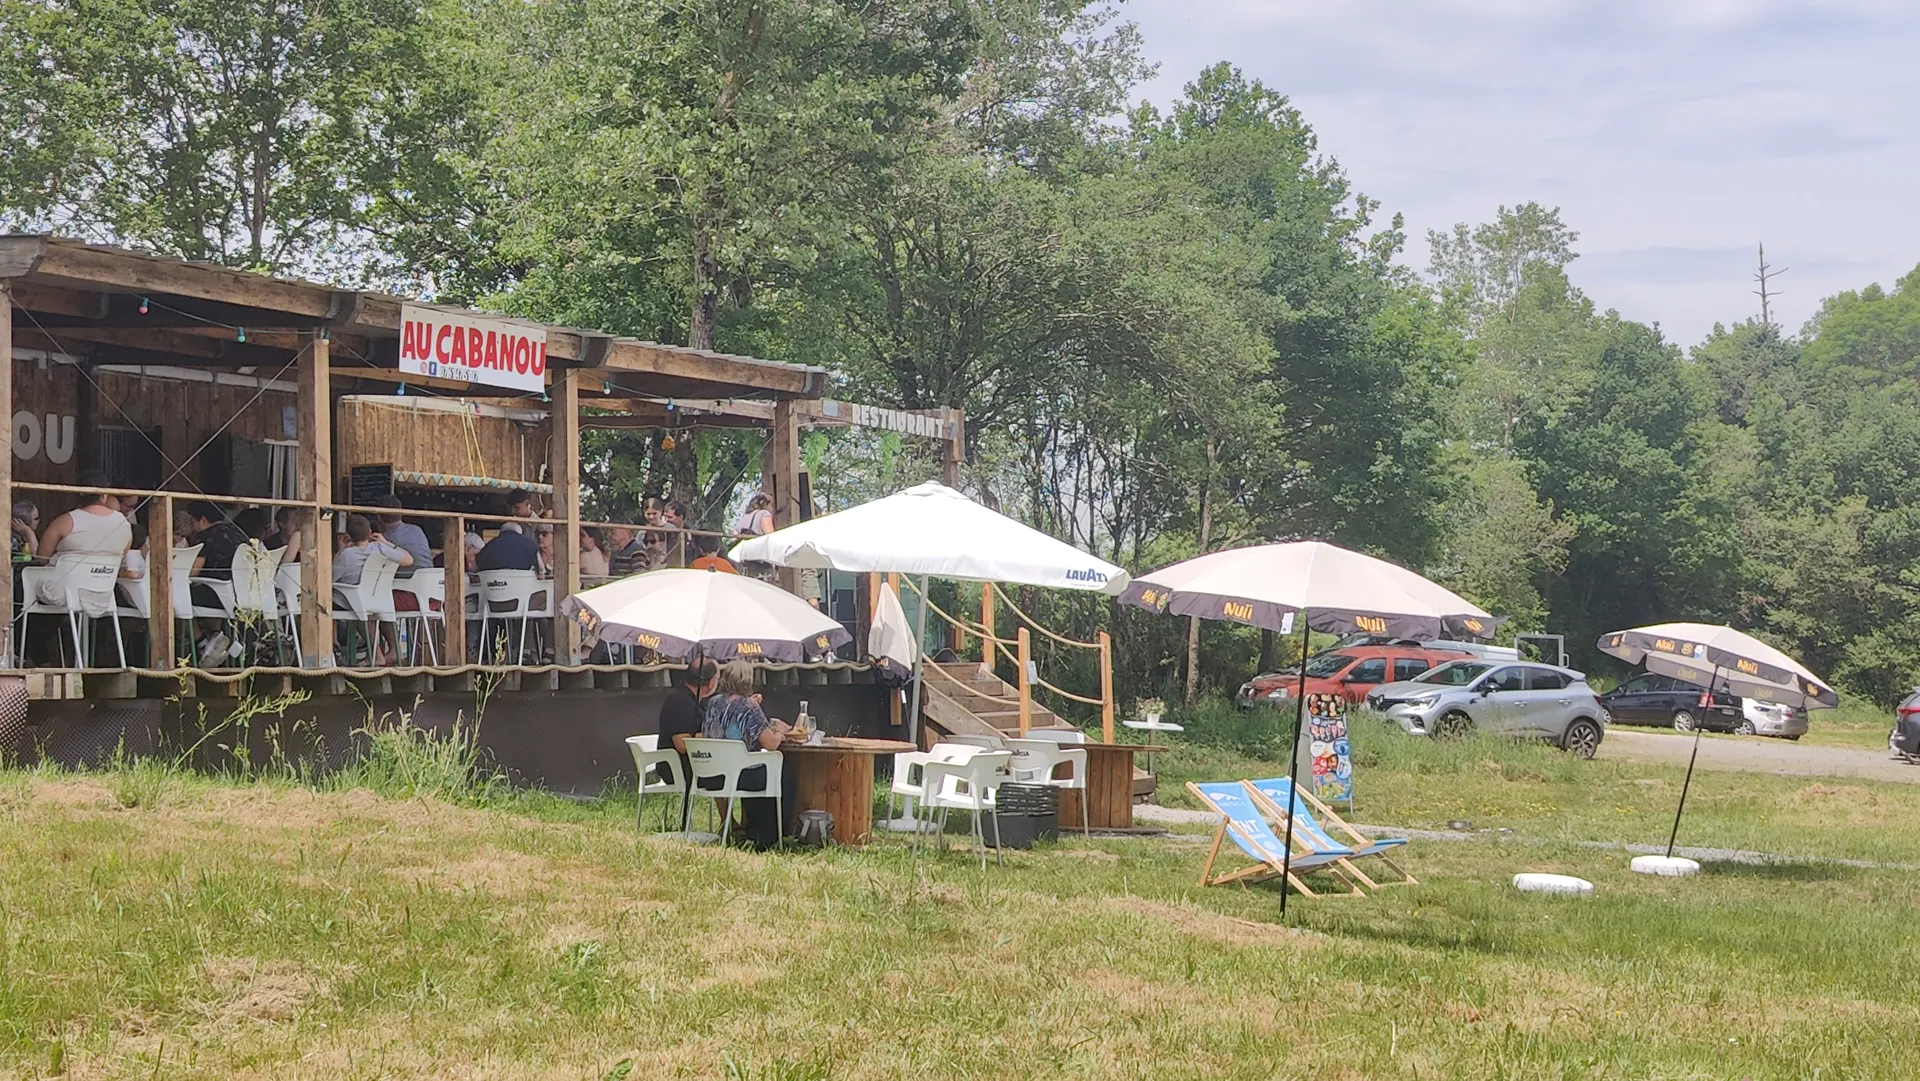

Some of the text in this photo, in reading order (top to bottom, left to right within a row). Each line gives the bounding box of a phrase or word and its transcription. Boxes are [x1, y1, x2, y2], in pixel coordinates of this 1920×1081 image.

[402, 320, 547, 377] AU CABANOU
[852, 402, 945, 439] RESTAURANT
[1223, 601, 1254, 620] Nuii
[737, 641, 762, 655] Nuii
